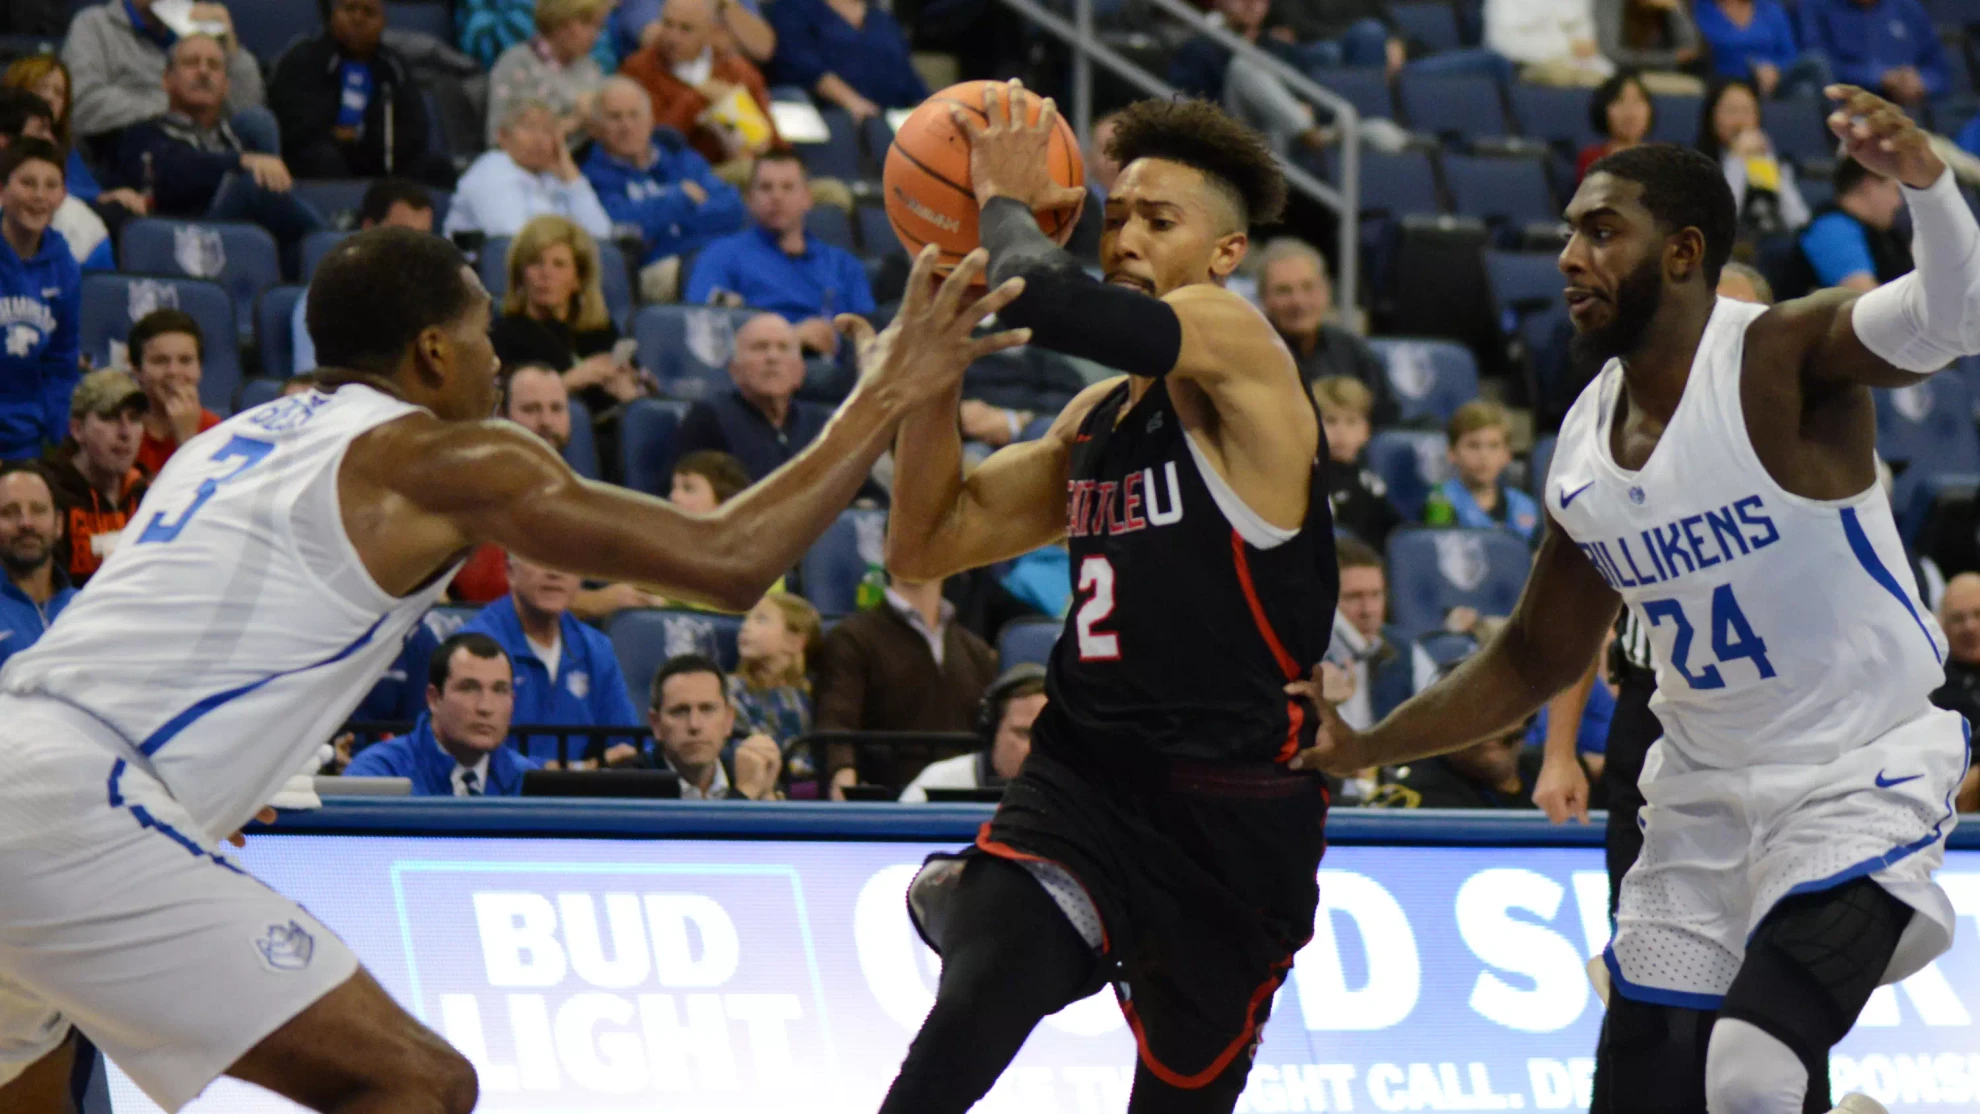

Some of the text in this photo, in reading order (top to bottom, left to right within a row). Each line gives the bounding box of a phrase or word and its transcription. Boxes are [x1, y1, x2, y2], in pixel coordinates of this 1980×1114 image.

[136, 434, 276, 543] 3
[1077, 554, 1121, 661] 2
[1641, 583, 1777, 689] 24
[472, 892, 739, 987] BUD
[440, 993, 804, 1094] LIGHT
[1366, 1062, 1525, 1110] CALL.
